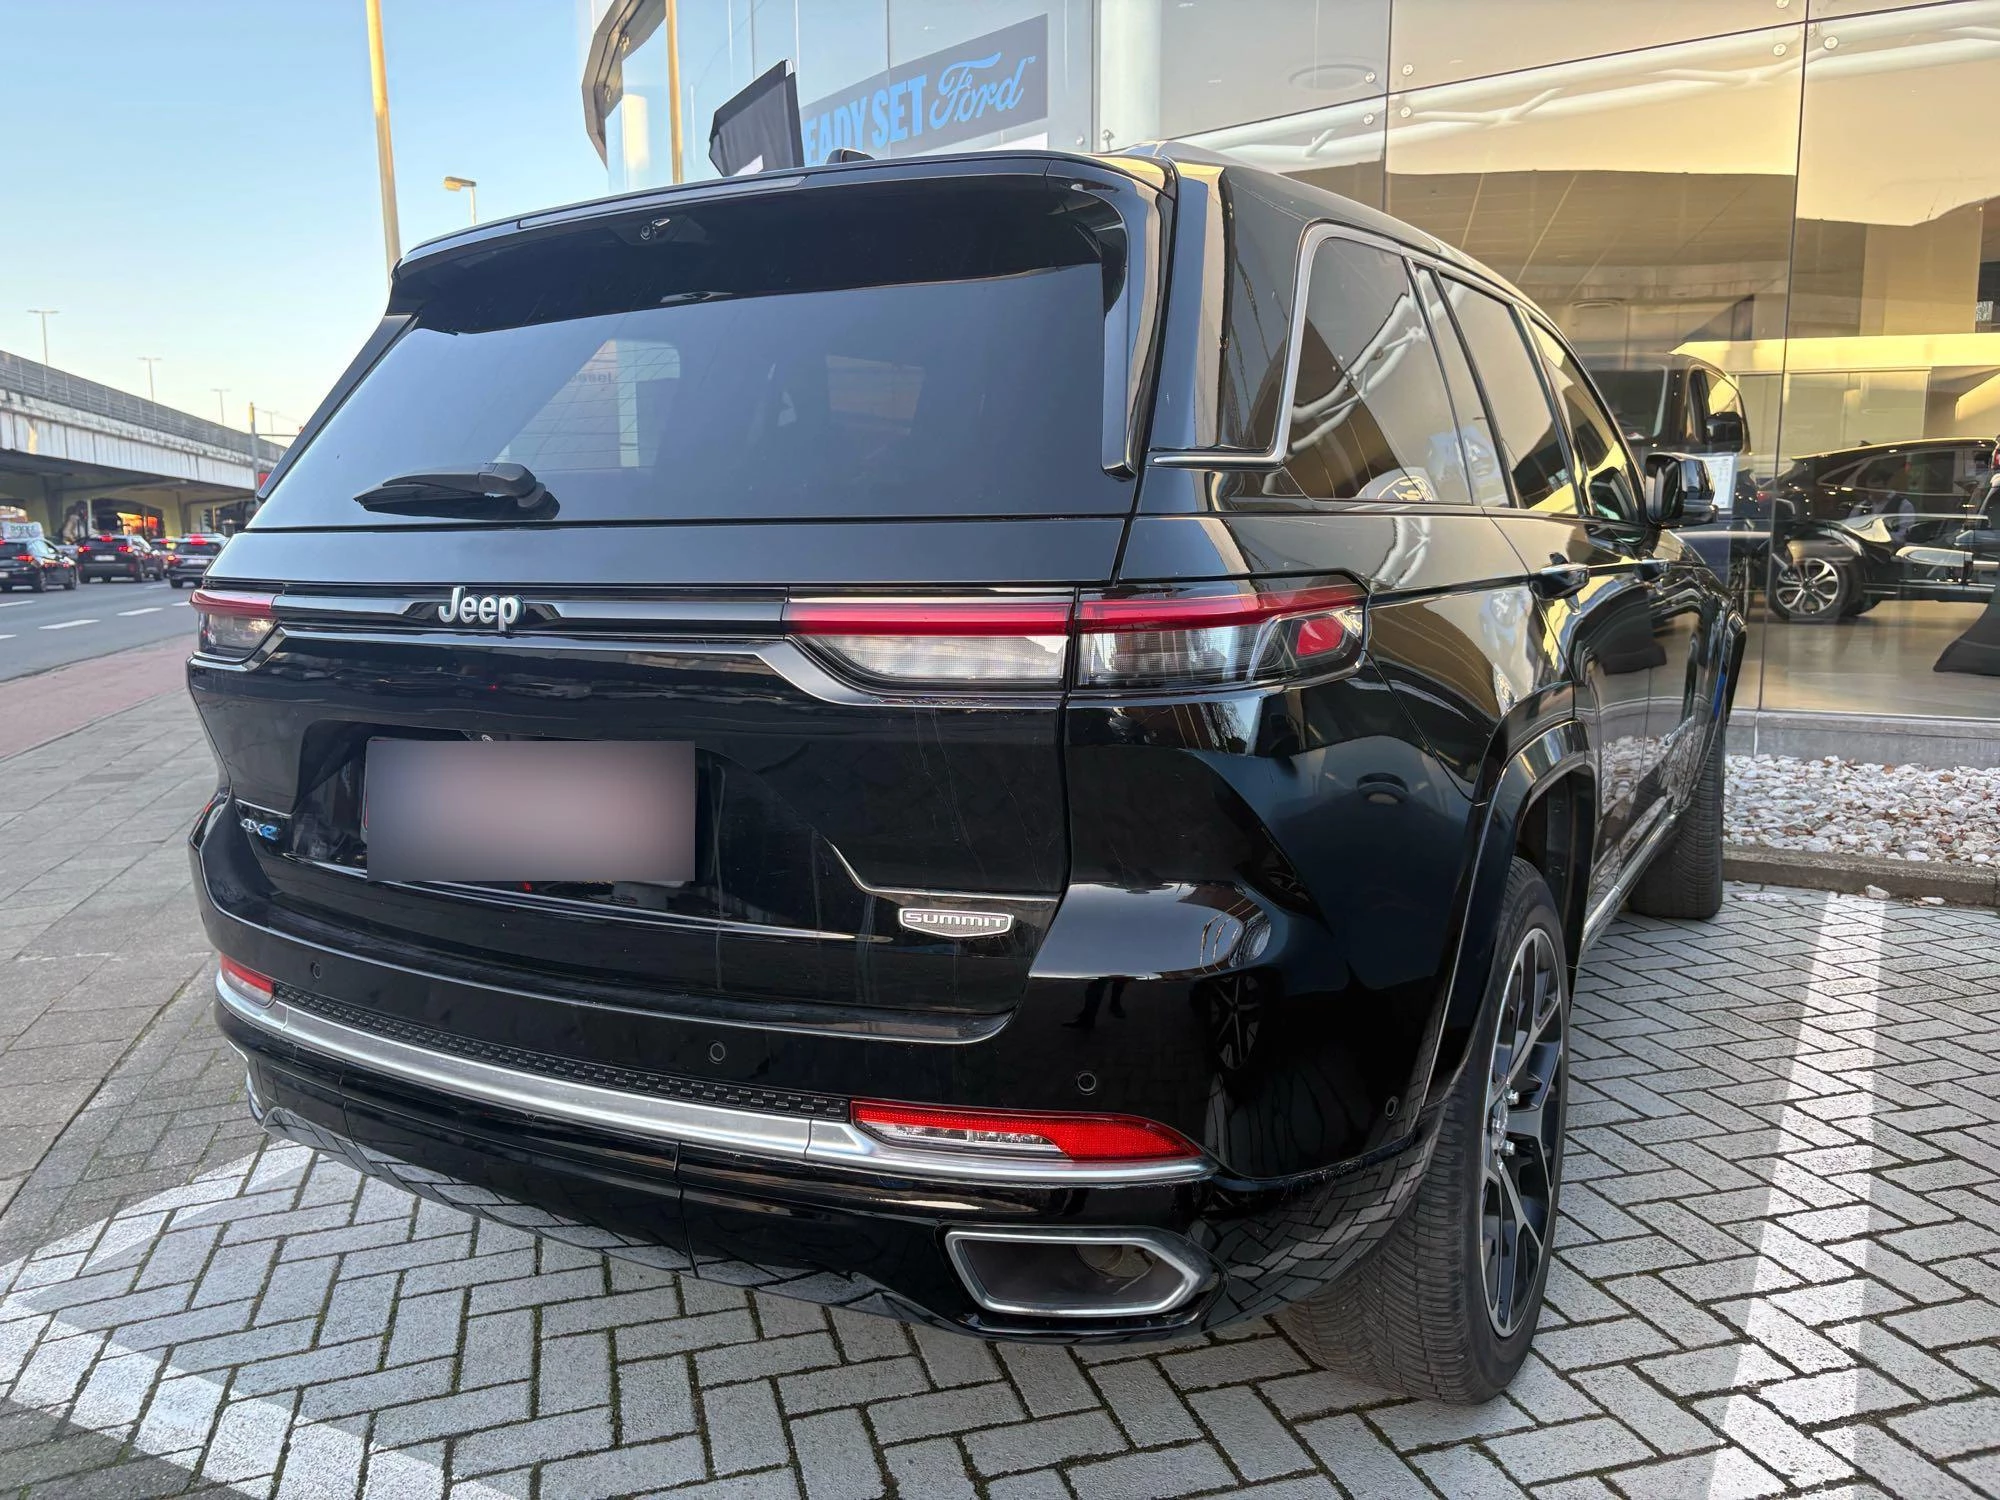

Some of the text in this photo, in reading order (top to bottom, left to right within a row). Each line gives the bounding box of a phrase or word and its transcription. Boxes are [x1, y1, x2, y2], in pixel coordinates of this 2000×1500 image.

[803, 52, 1026, 167] EADY SET Ford
[438, 585, 520, 631] Jeep
[904, 912, 1006, 927] SUMMIT
